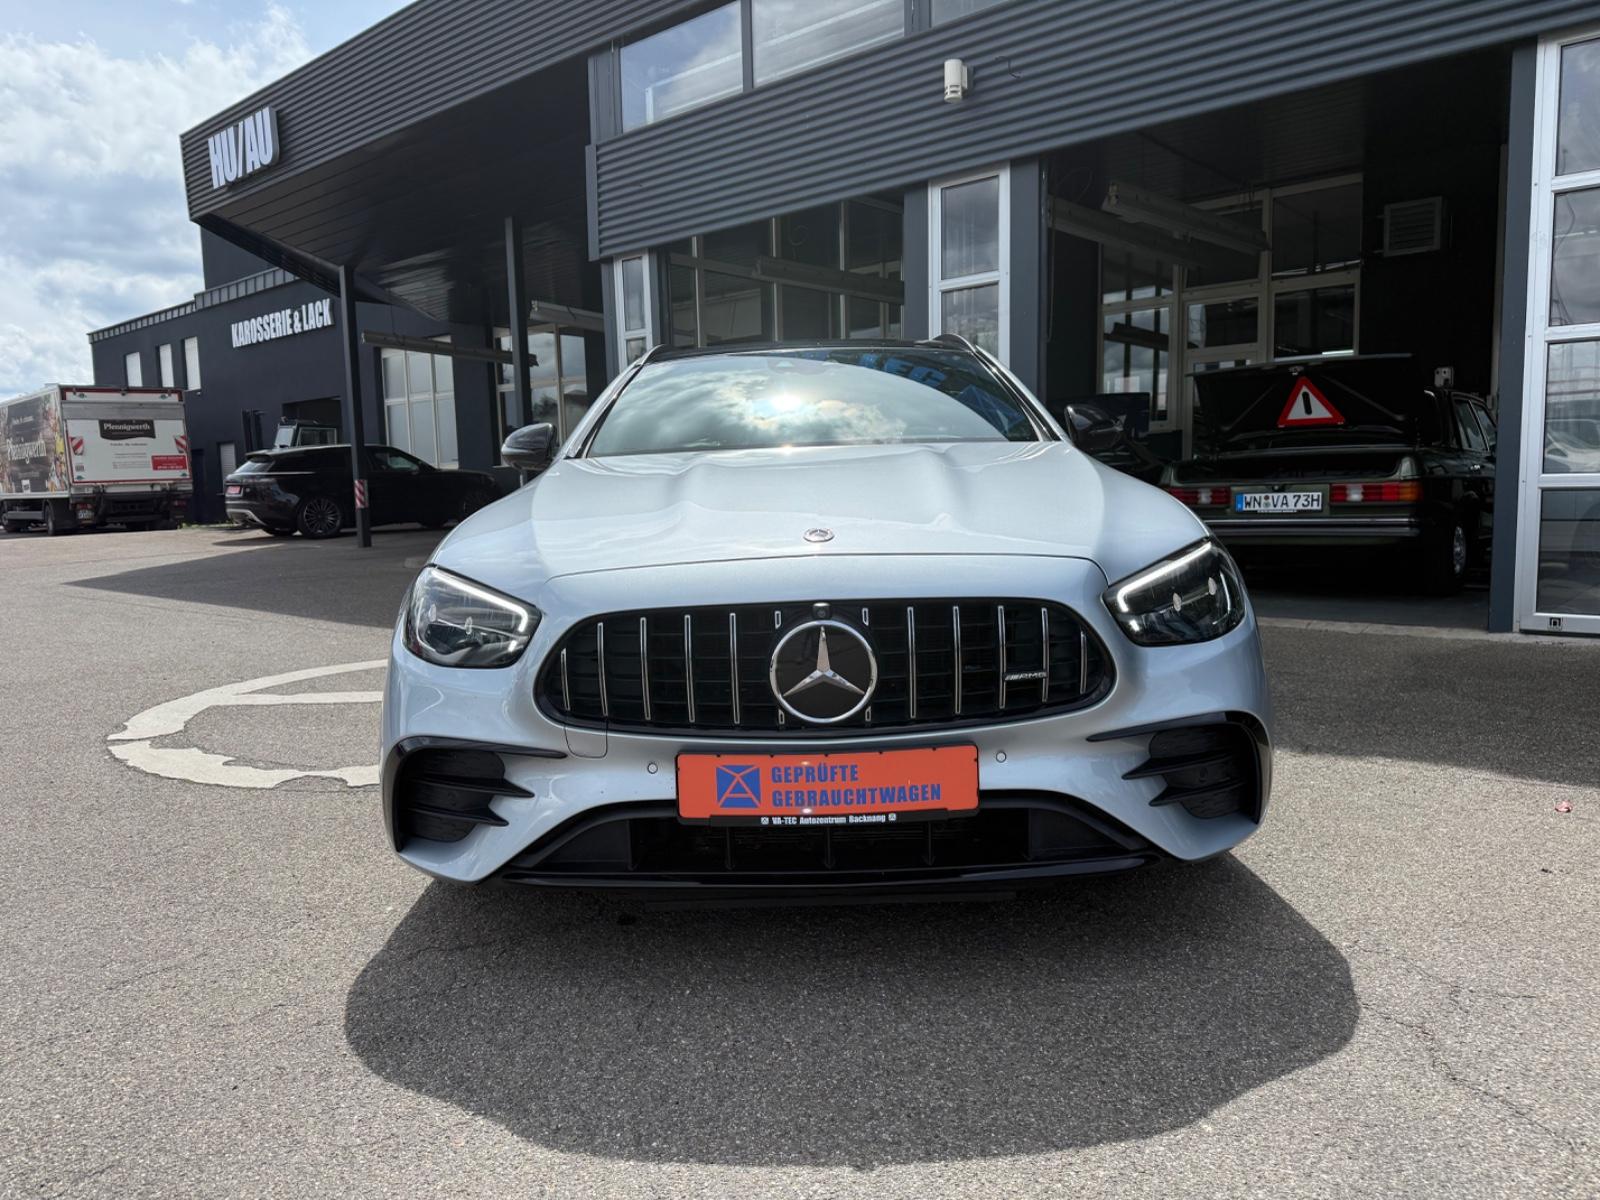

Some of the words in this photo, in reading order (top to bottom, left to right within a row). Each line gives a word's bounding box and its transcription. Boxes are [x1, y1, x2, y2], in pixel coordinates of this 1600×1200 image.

[208, 106, 273, 189] HU/AU
[231, 309, 293, 348] KAROSSERIE
[293, 310, 302, 334] &
[301, 298, 331, 331] LACK
[771, 762, 859, 784] GEPRÜFTE
[771, 784, 941, 807] GEBRAUCHTWAGEN
[772, 816, 797, 825] VA-TEC
[799, 816, 847, 825] Autozentrum
[848, 814, 886, 824] Backnang
